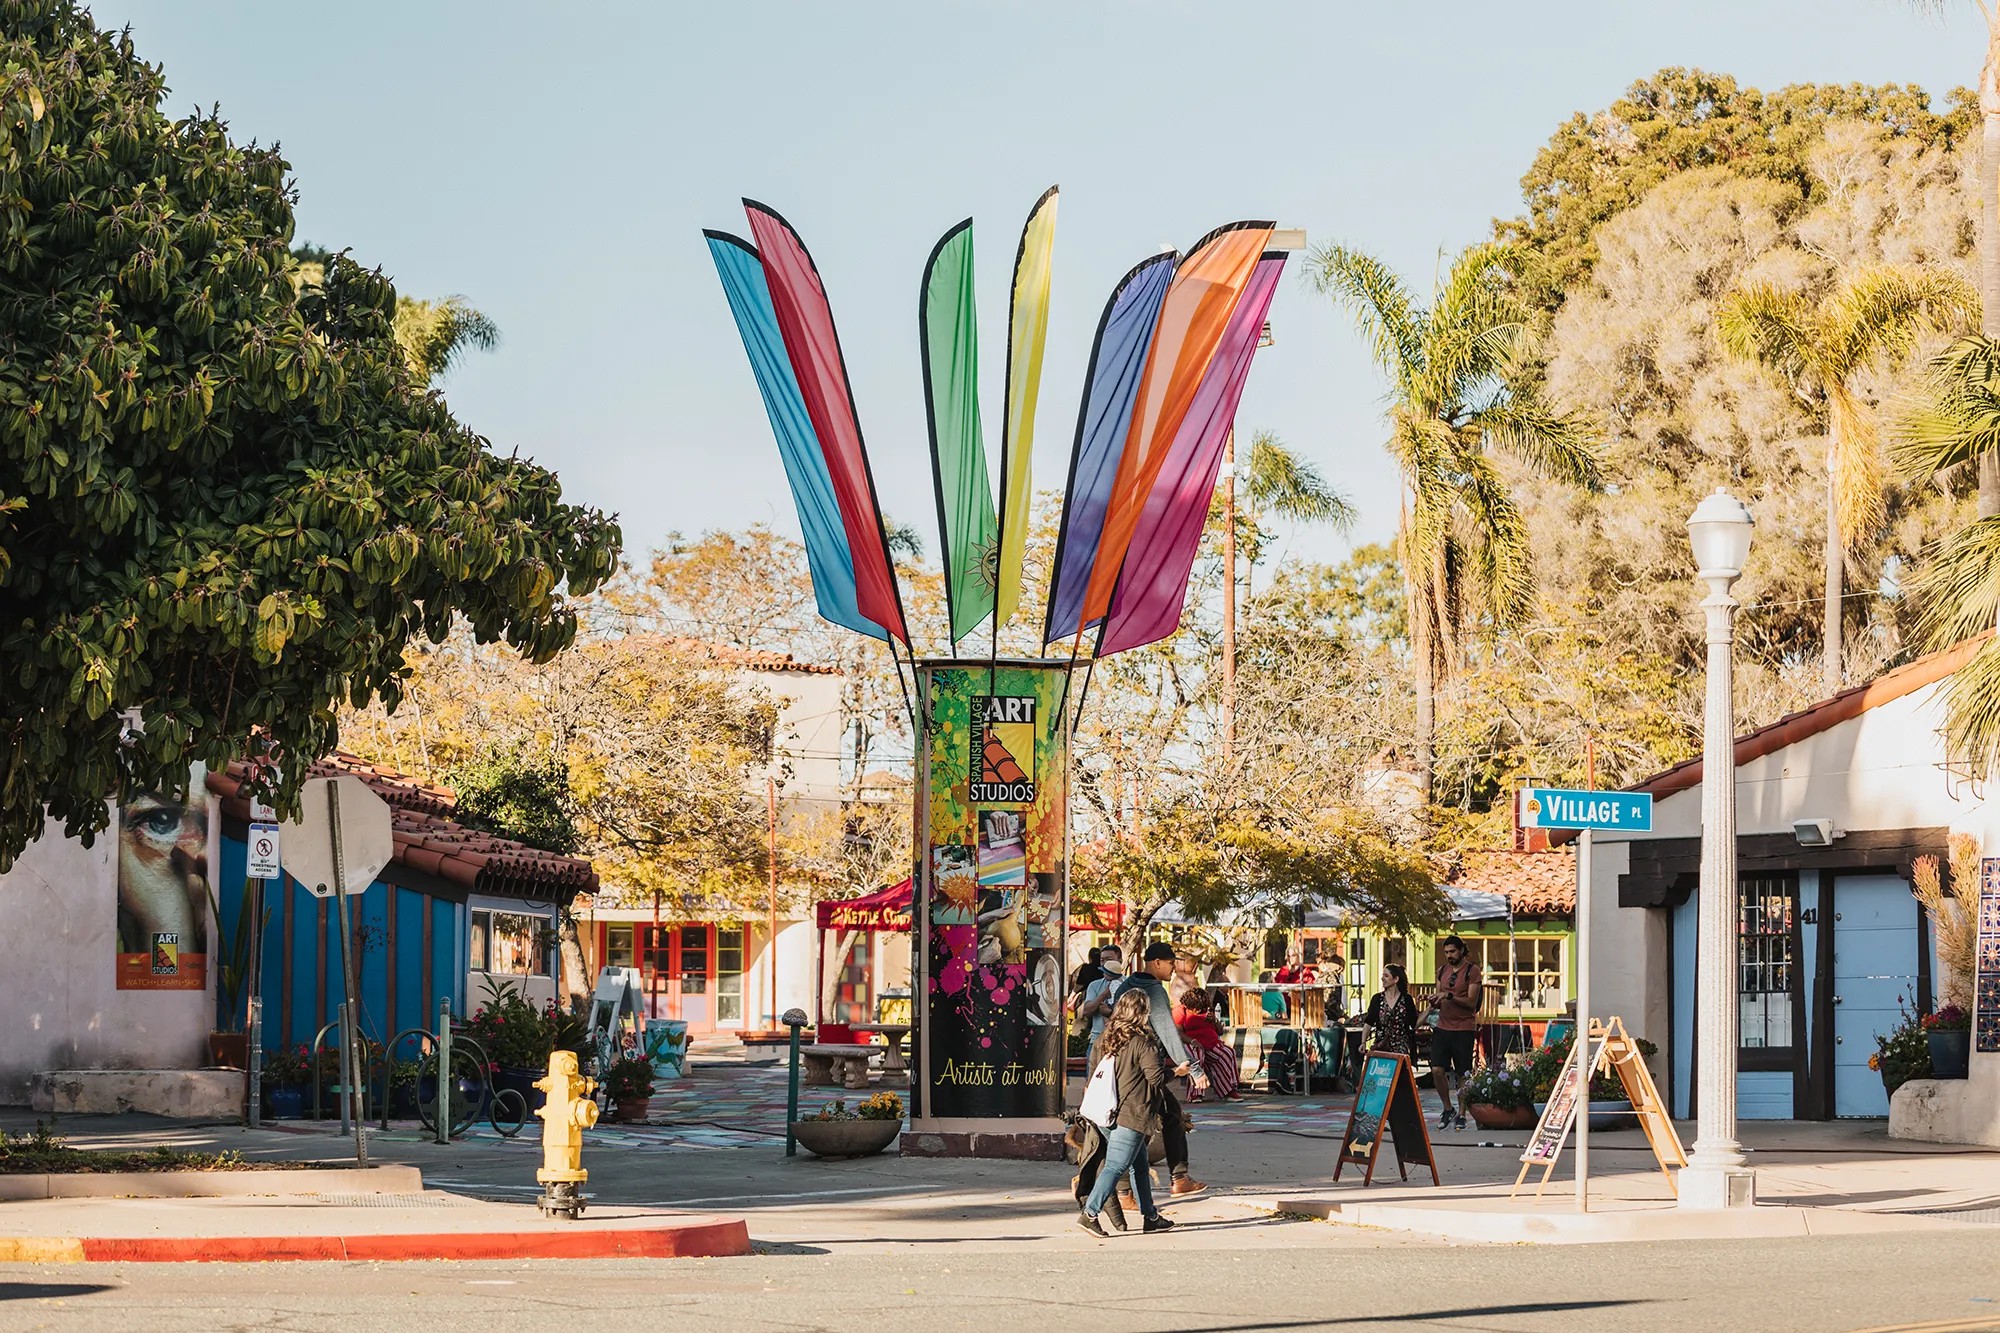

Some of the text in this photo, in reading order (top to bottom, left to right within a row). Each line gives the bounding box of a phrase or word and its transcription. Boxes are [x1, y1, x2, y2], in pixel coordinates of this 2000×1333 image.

[983, 697, 1035, 722] ART
[971, 697, 983, 783] SPANISH VILLAGE
[970, 784, 1034, 801] STUDIOS
[1546, 795, 1642, 823] VILLAGE PL
[843, 907, 879, 925] KETTLE
[1800, 907, 1817, 925] 41
[157, 934, 178, 943] ART
[152, 966, 177, 974] STUDIOS
[934, 1057, 996, 1086] Artists
[1001, 1062, 1024, 1086] at
[1024, 1058, 1057, 1086] work
